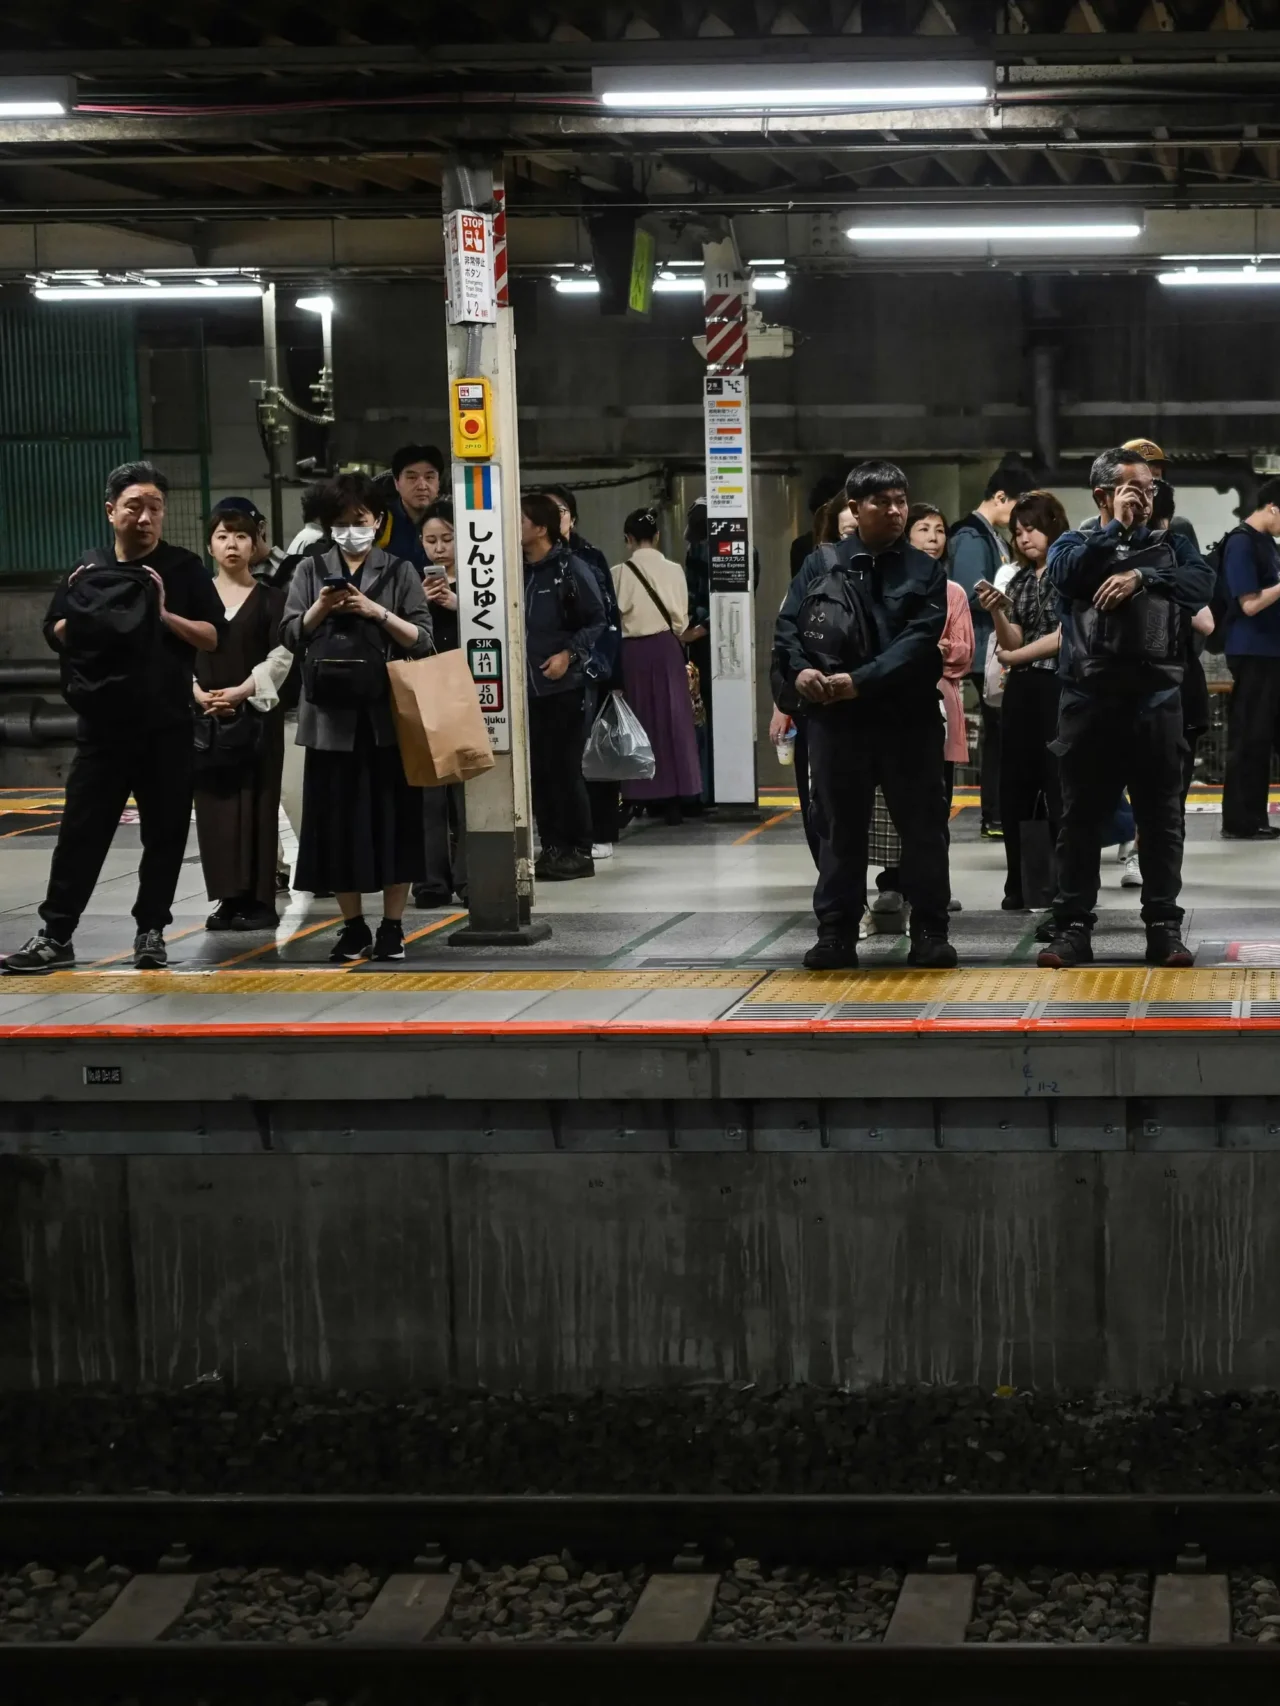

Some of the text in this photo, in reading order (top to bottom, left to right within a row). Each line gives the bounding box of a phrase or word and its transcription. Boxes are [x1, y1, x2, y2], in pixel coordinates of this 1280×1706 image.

[463, 217, 483, 228] STOP
[464, 256, 486, 268] 非常停止
[465, 268, 481, 278] ボタン
[716, 273, 728, 288] 11
[467, 521, 497, 631] しんじゅく
[476, 640, 492, 648] SJK
[479, 653, 490, 661] JA
[478, 662, 492, 673] 11
[480, 685, 491, 693] JS
[478, 693, 494, 705] 20
